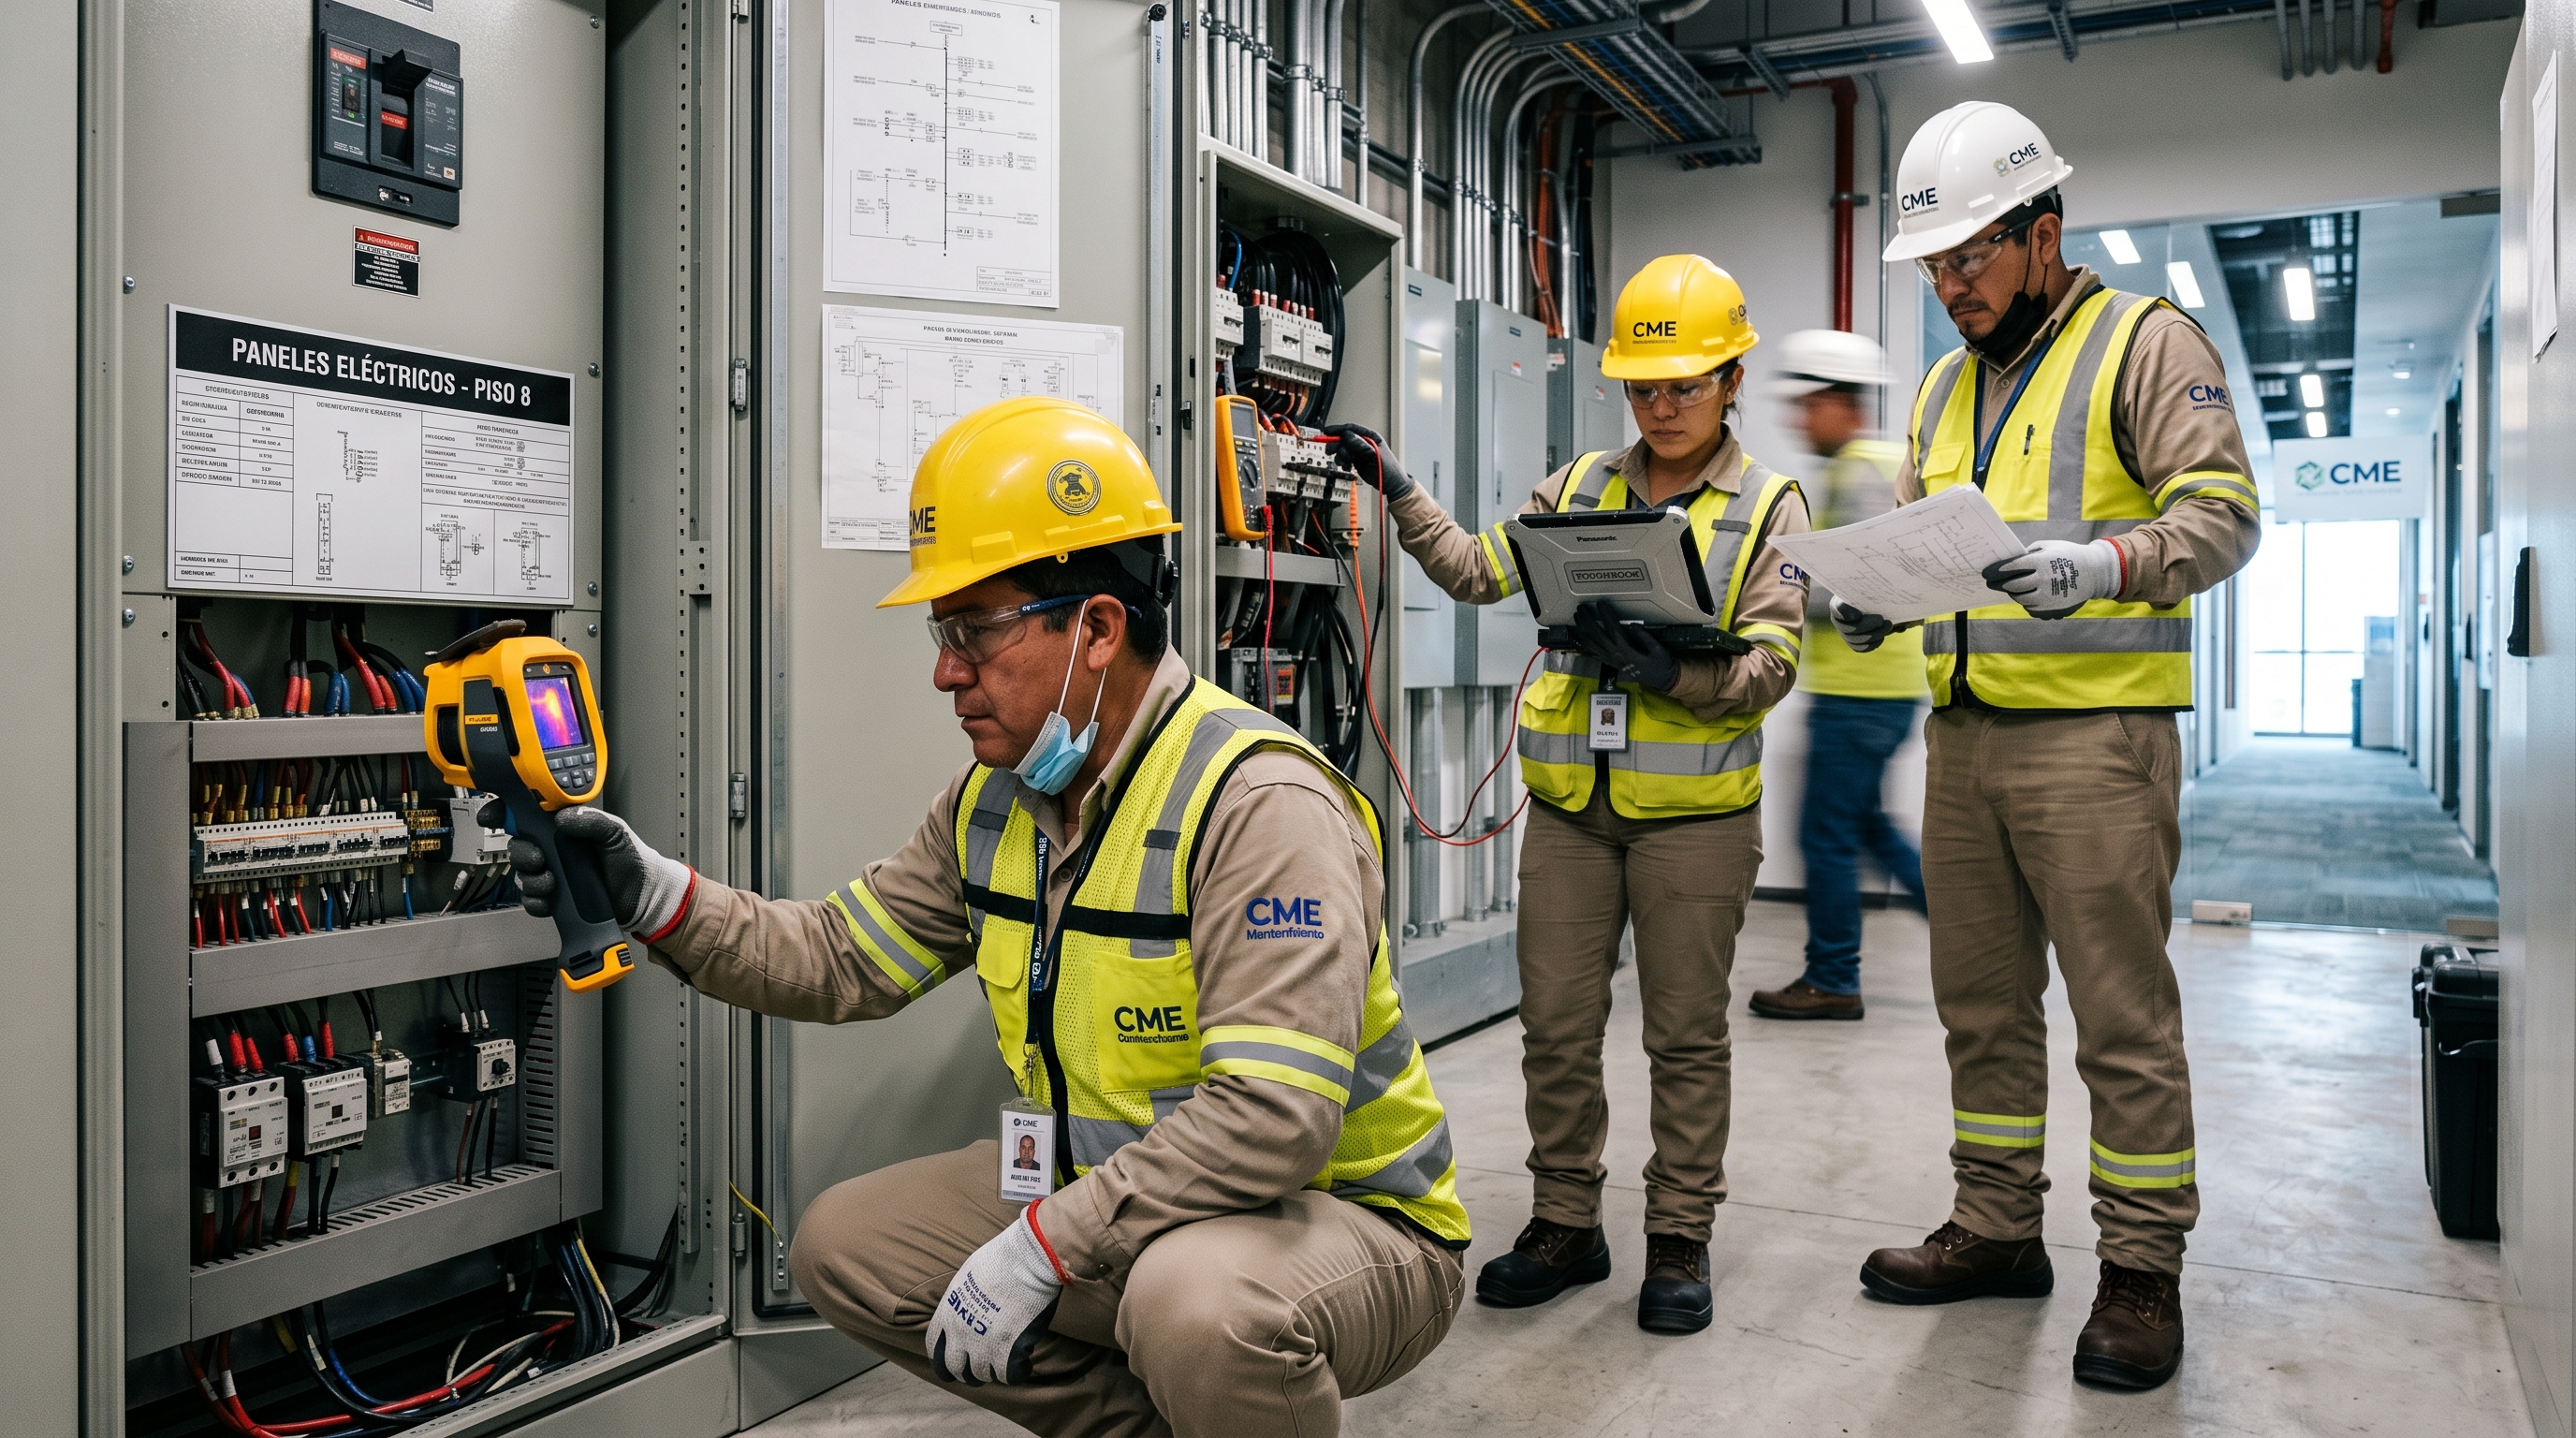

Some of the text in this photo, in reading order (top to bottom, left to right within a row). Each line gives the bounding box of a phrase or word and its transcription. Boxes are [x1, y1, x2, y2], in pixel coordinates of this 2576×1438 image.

[2009, 142, 2040, 165] CME
[1901, 187, 1939, 212] CME
[1632, 321, 1676, 338] CME
[232, 337, 329, 376] PANELES
[337, 353, 456, 395] ELÉCTRICOS
[475, 377, 515, 404] PISO
[520, 386, 531, 406] 8
[2188, 385, 2229, 405] CME
[2330, 461, 2401, 485] CME
[910, 506, 936, 536] ME
[1246, 896, 1322, 926] CME
[1114, 1005, 1186, 1033] CME
